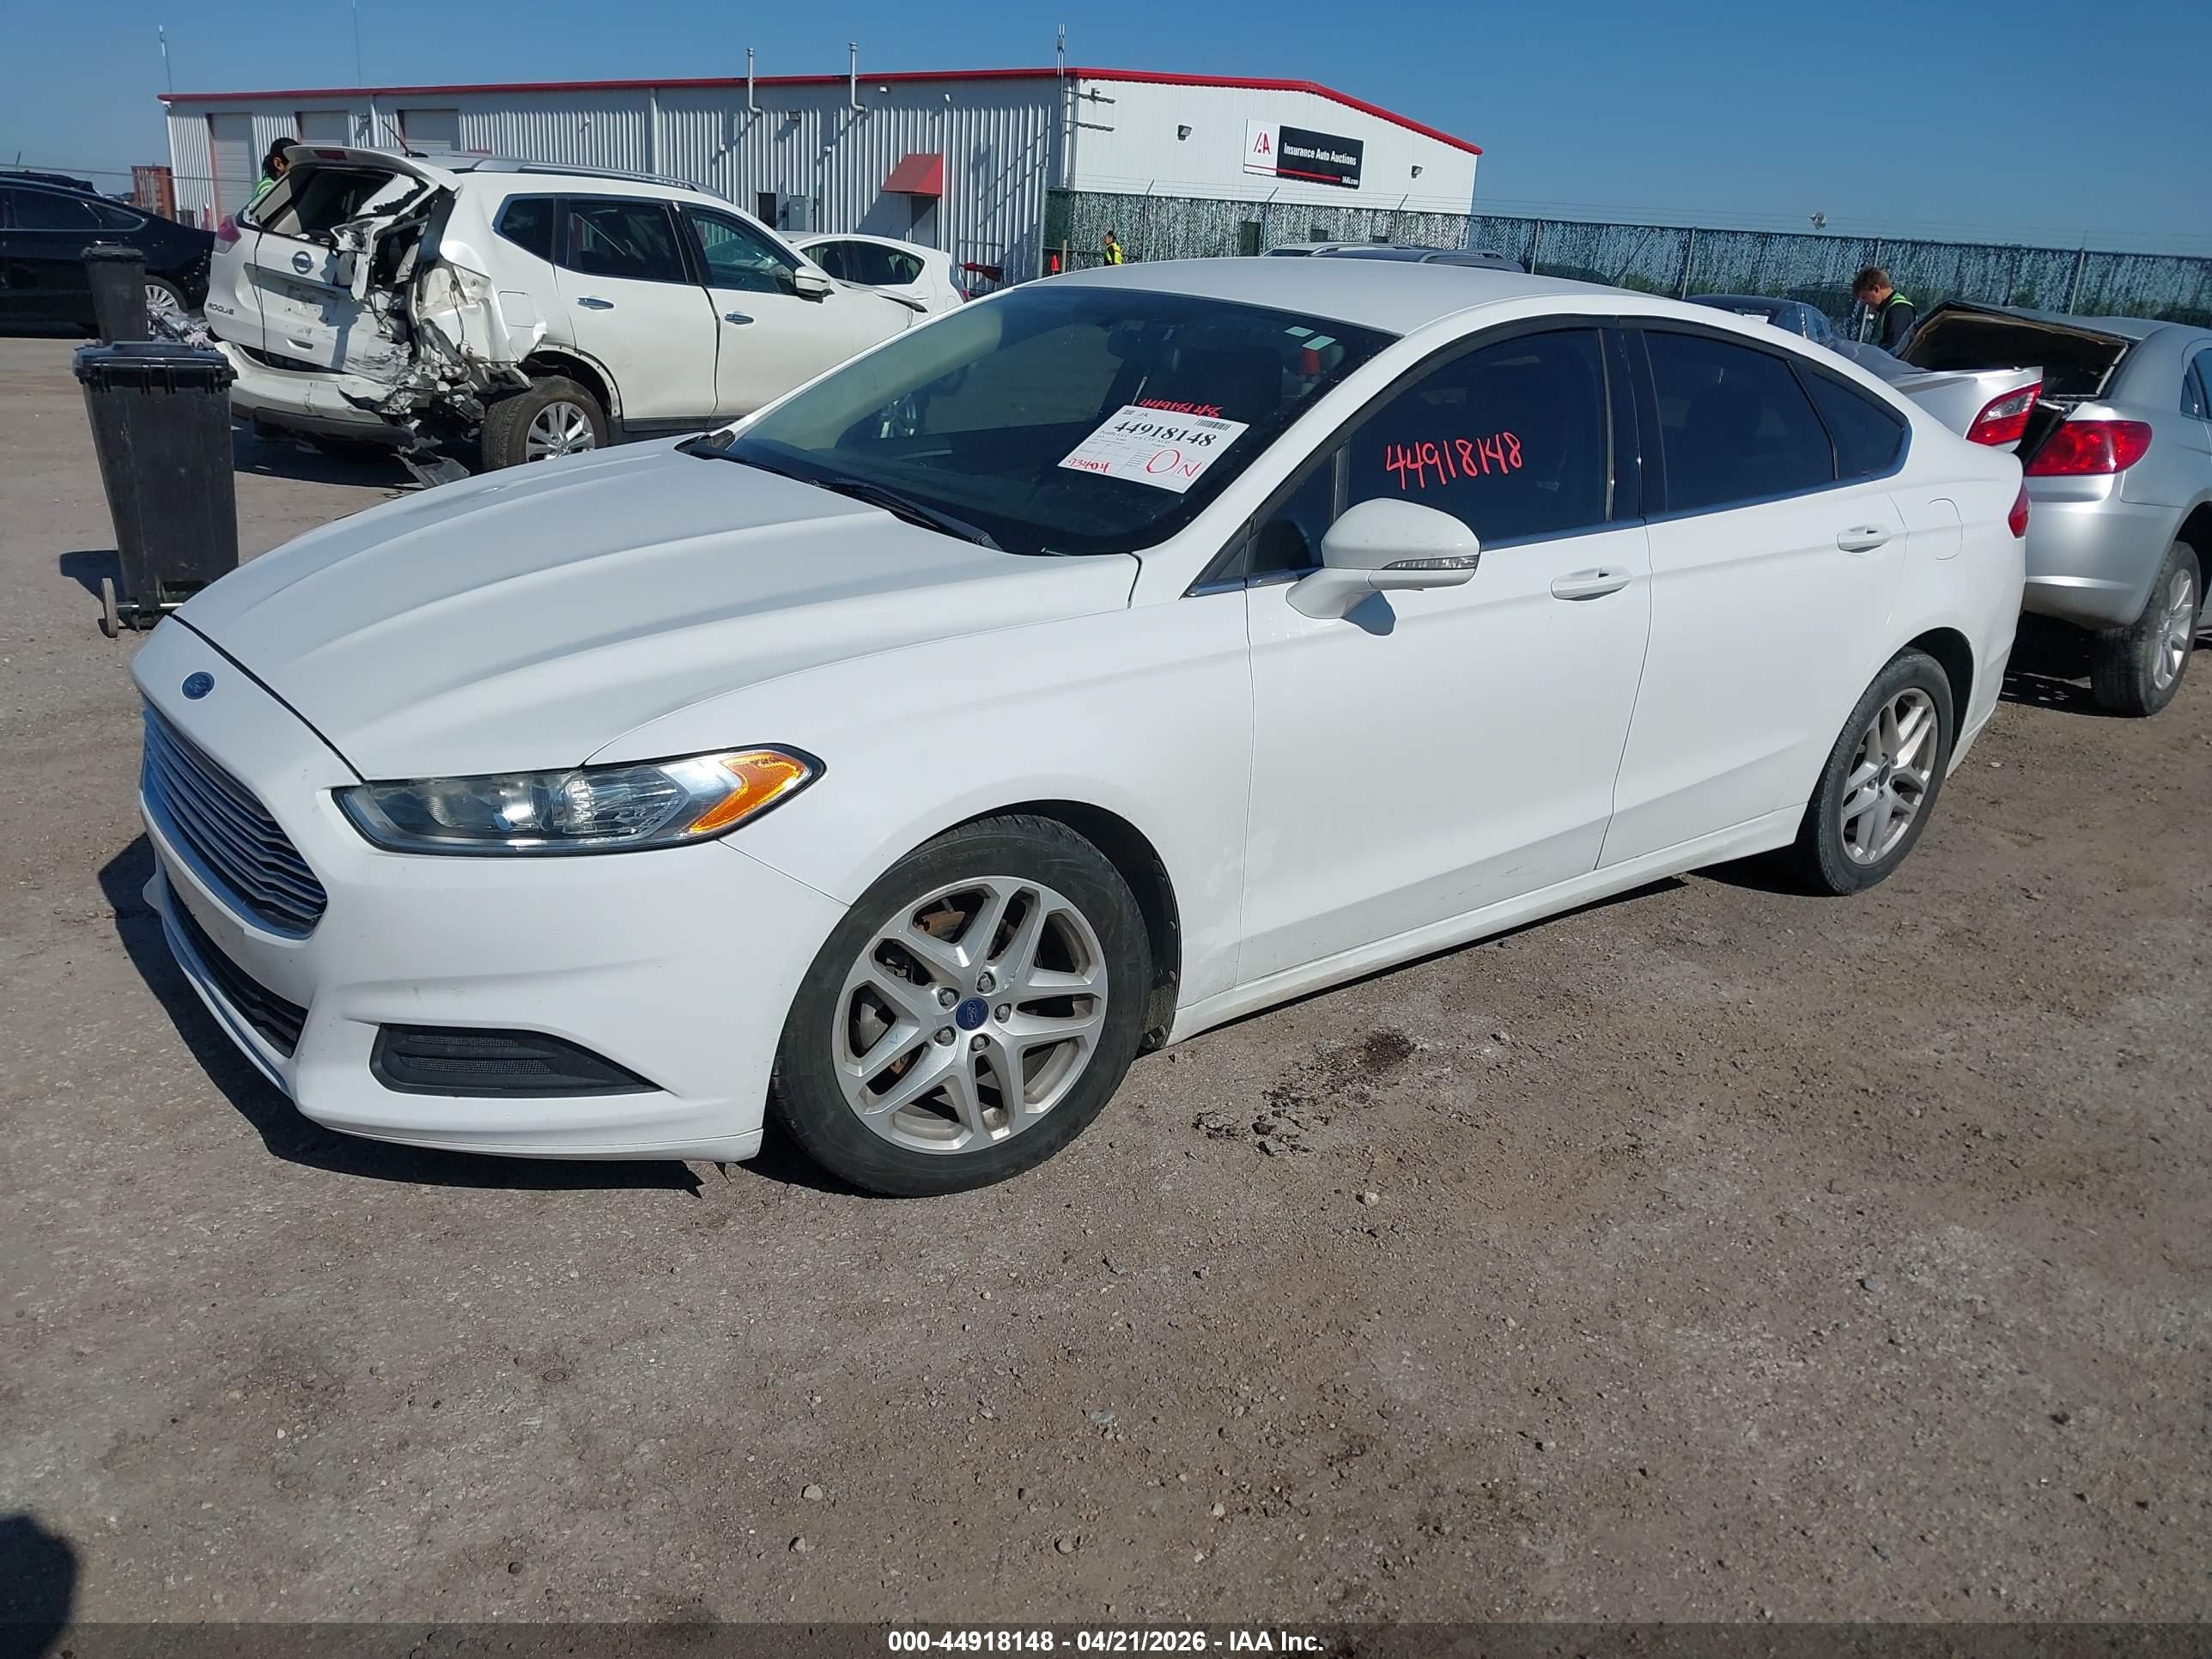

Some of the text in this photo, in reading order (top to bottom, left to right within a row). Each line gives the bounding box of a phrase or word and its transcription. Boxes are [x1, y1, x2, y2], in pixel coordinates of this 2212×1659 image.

[1284, 142, 1357, 166] Insurance Auto Auctions
[207, 302, 234, 315] ROGUE
[1114, 420, 1217, 447] 44918148
[1386, 431, 1522, 490] 44918148
[968, 1006, 976, 1023] Ford
